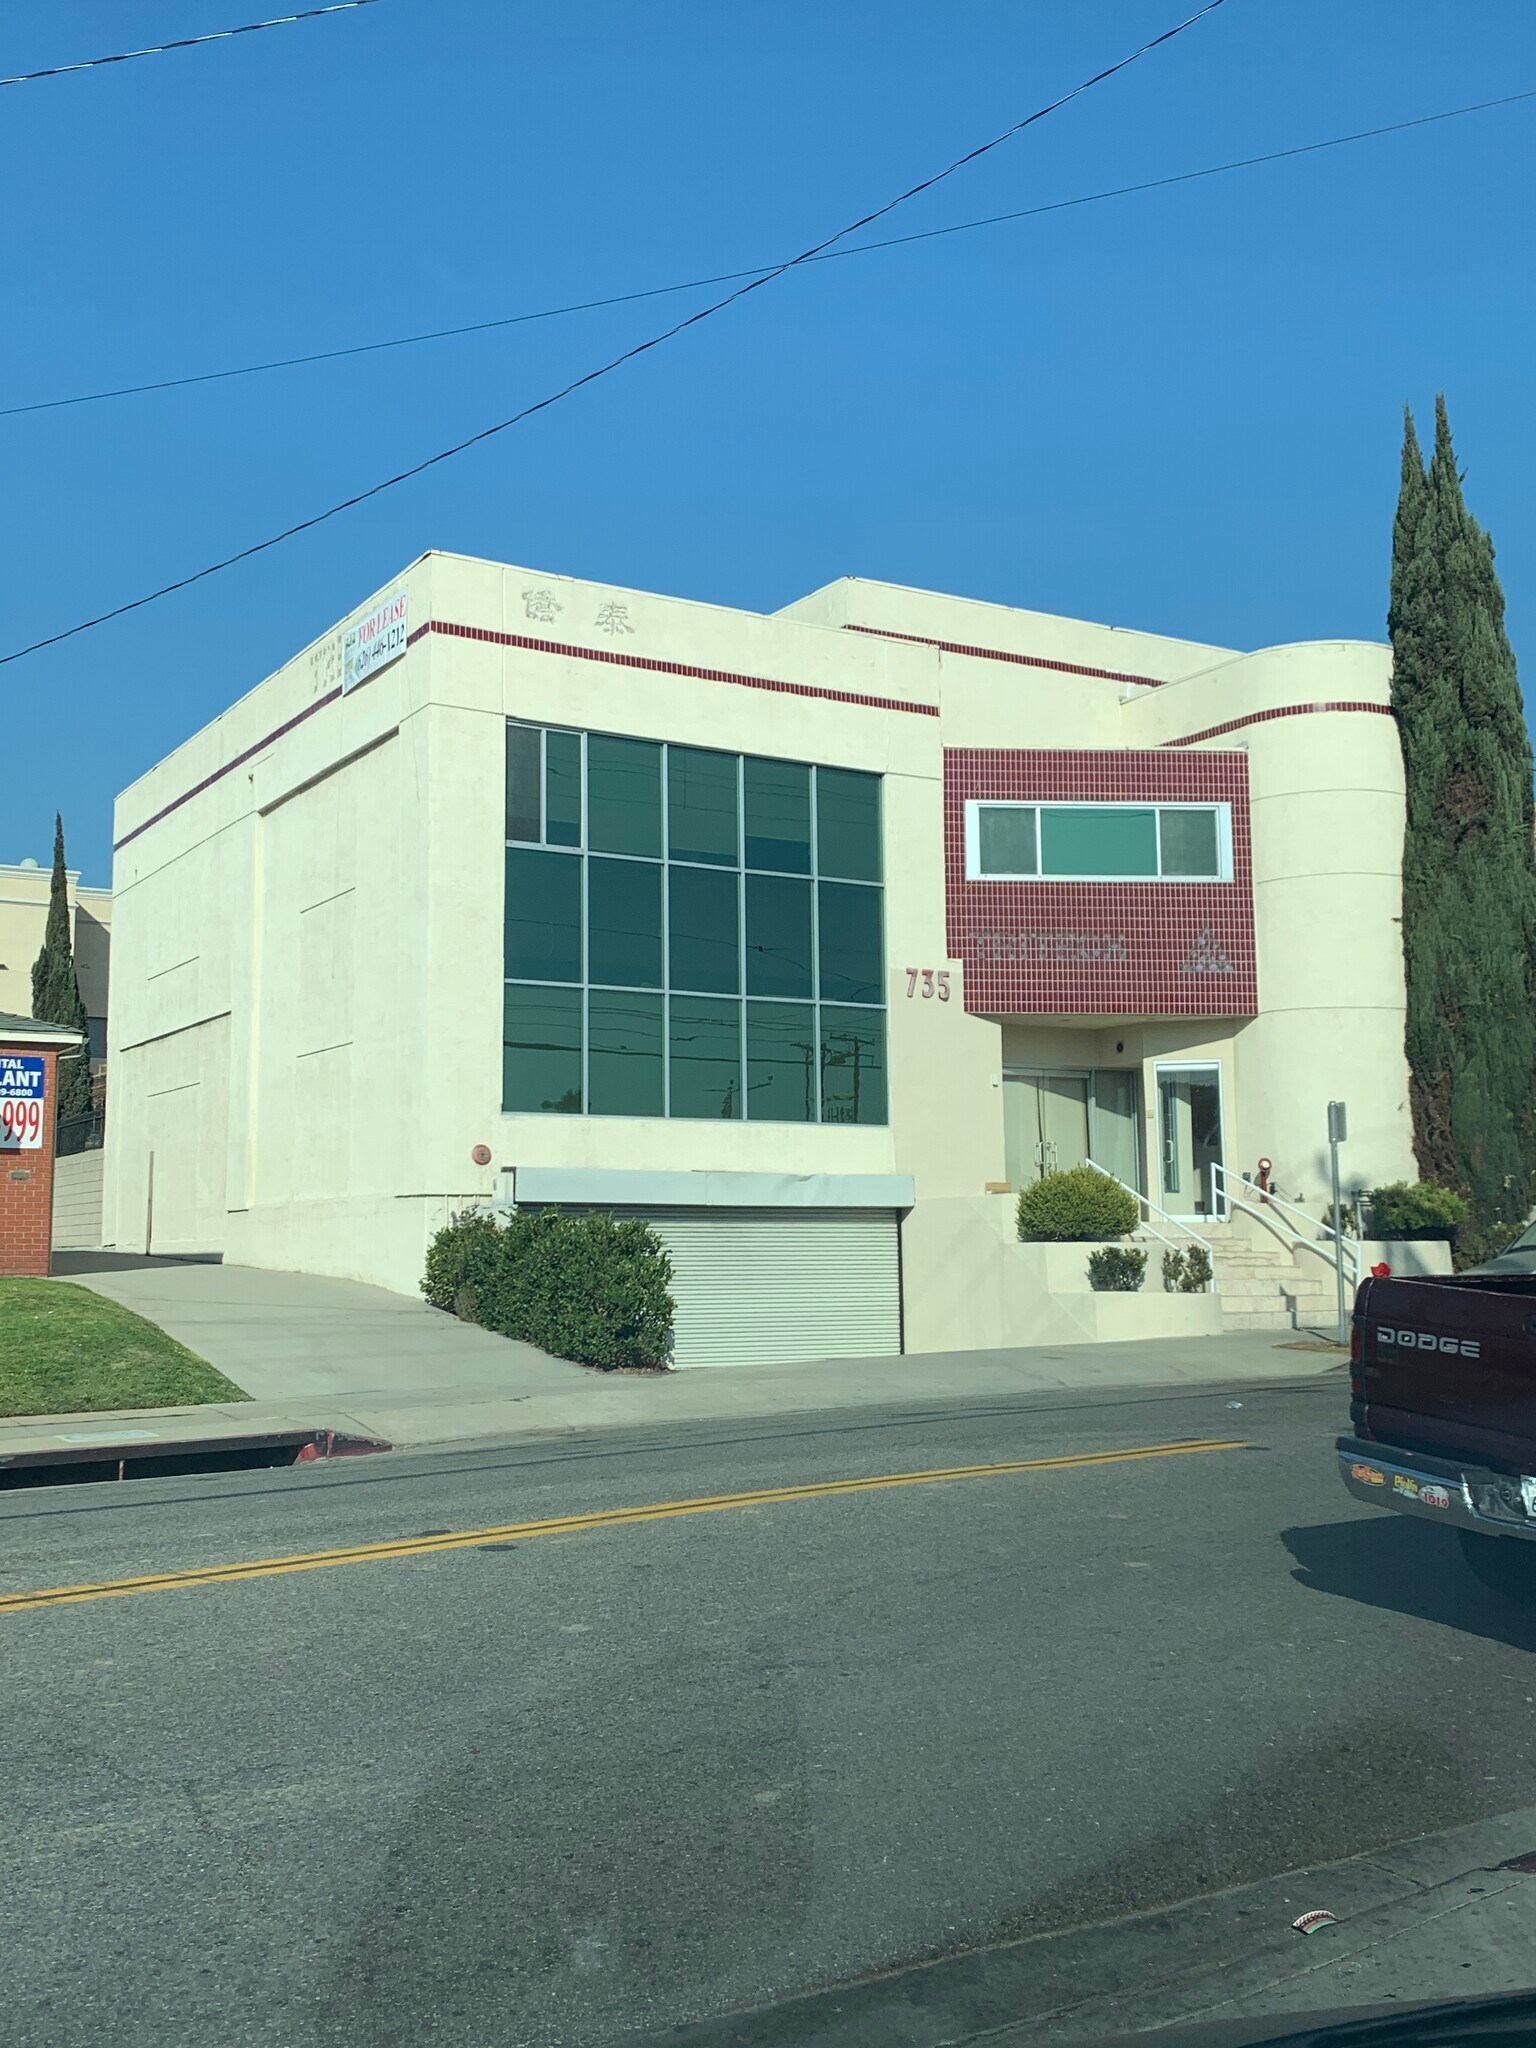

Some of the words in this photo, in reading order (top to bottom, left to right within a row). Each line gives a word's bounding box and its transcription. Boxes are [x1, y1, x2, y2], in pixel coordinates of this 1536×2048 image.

[357, 616, 376, 648] FOR
[376, 594, 406, 635] LEASE
[905, 967, 951, 1002] 735
[0, 1058, 24, 1070] TAL
[0, 1070, 42, 1088] ANT
[1377, 1326, 1481, 1358] DODGE
